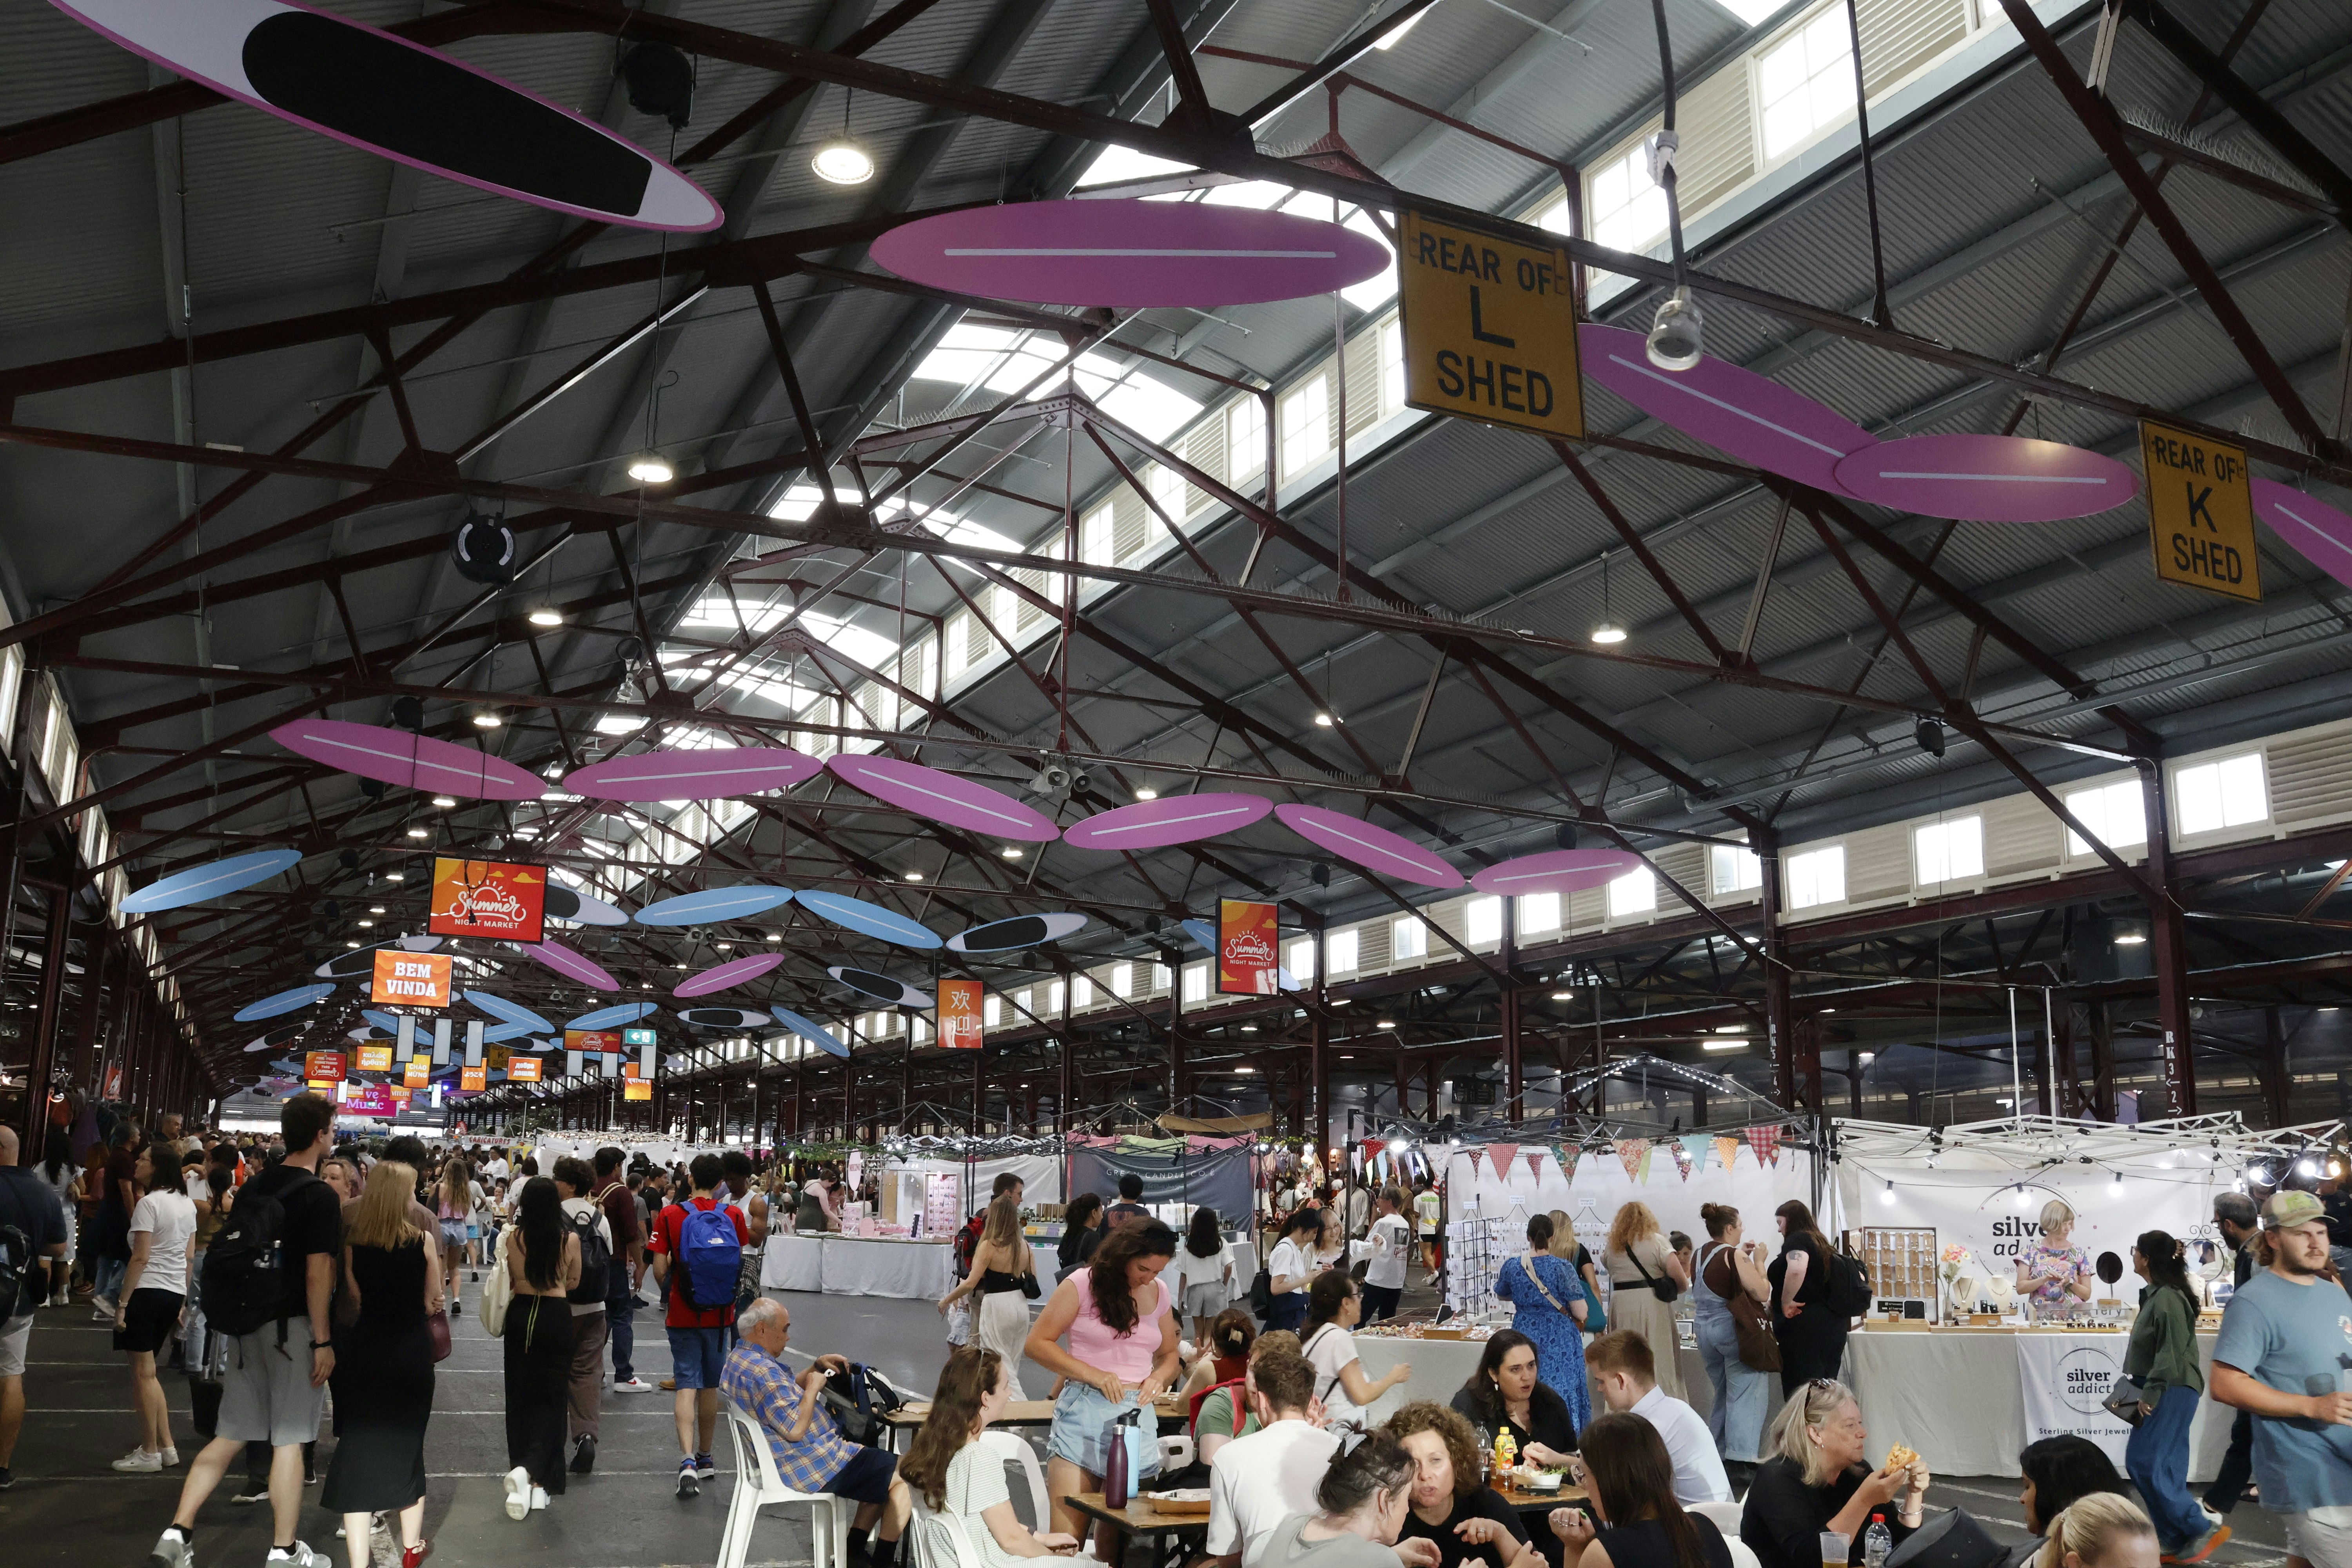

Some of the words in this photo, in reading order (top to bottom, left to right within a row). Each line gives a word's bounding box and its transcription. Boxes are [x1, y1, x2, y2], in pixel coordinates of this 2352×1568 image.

[1419, 232, 1502, 284] REAR
[1517, 258, 1553, 295] OF
[1470, 285, 1515, 349] L
[1436, 350, 1553, 417] SHED
[2155, 436, 2206, 476] REAR
[2214, 454, 2238, 483] OF
[2187, 481, 2217, 533] K
[2172, 533, 2243, 584] SHED
[450, 891, 526, 922] Summer
[484, 920, 519, 929] MARKET
[1225, 938, 1274, 961] Summer
[394, 962, 431, 978] BEM
[386, 979, 436, 997] VINDA
[951, 989, 970, 1036] 欢迎
[2171, 1091, 2177, 1103] 2
[469, 1136, 510, 1145] CARICATURES
[1992, 1216, 2047, 1237] silv
[2067, 1368, 2111, 1382] silver
[2068, 1383, 2111, 1394] addict
